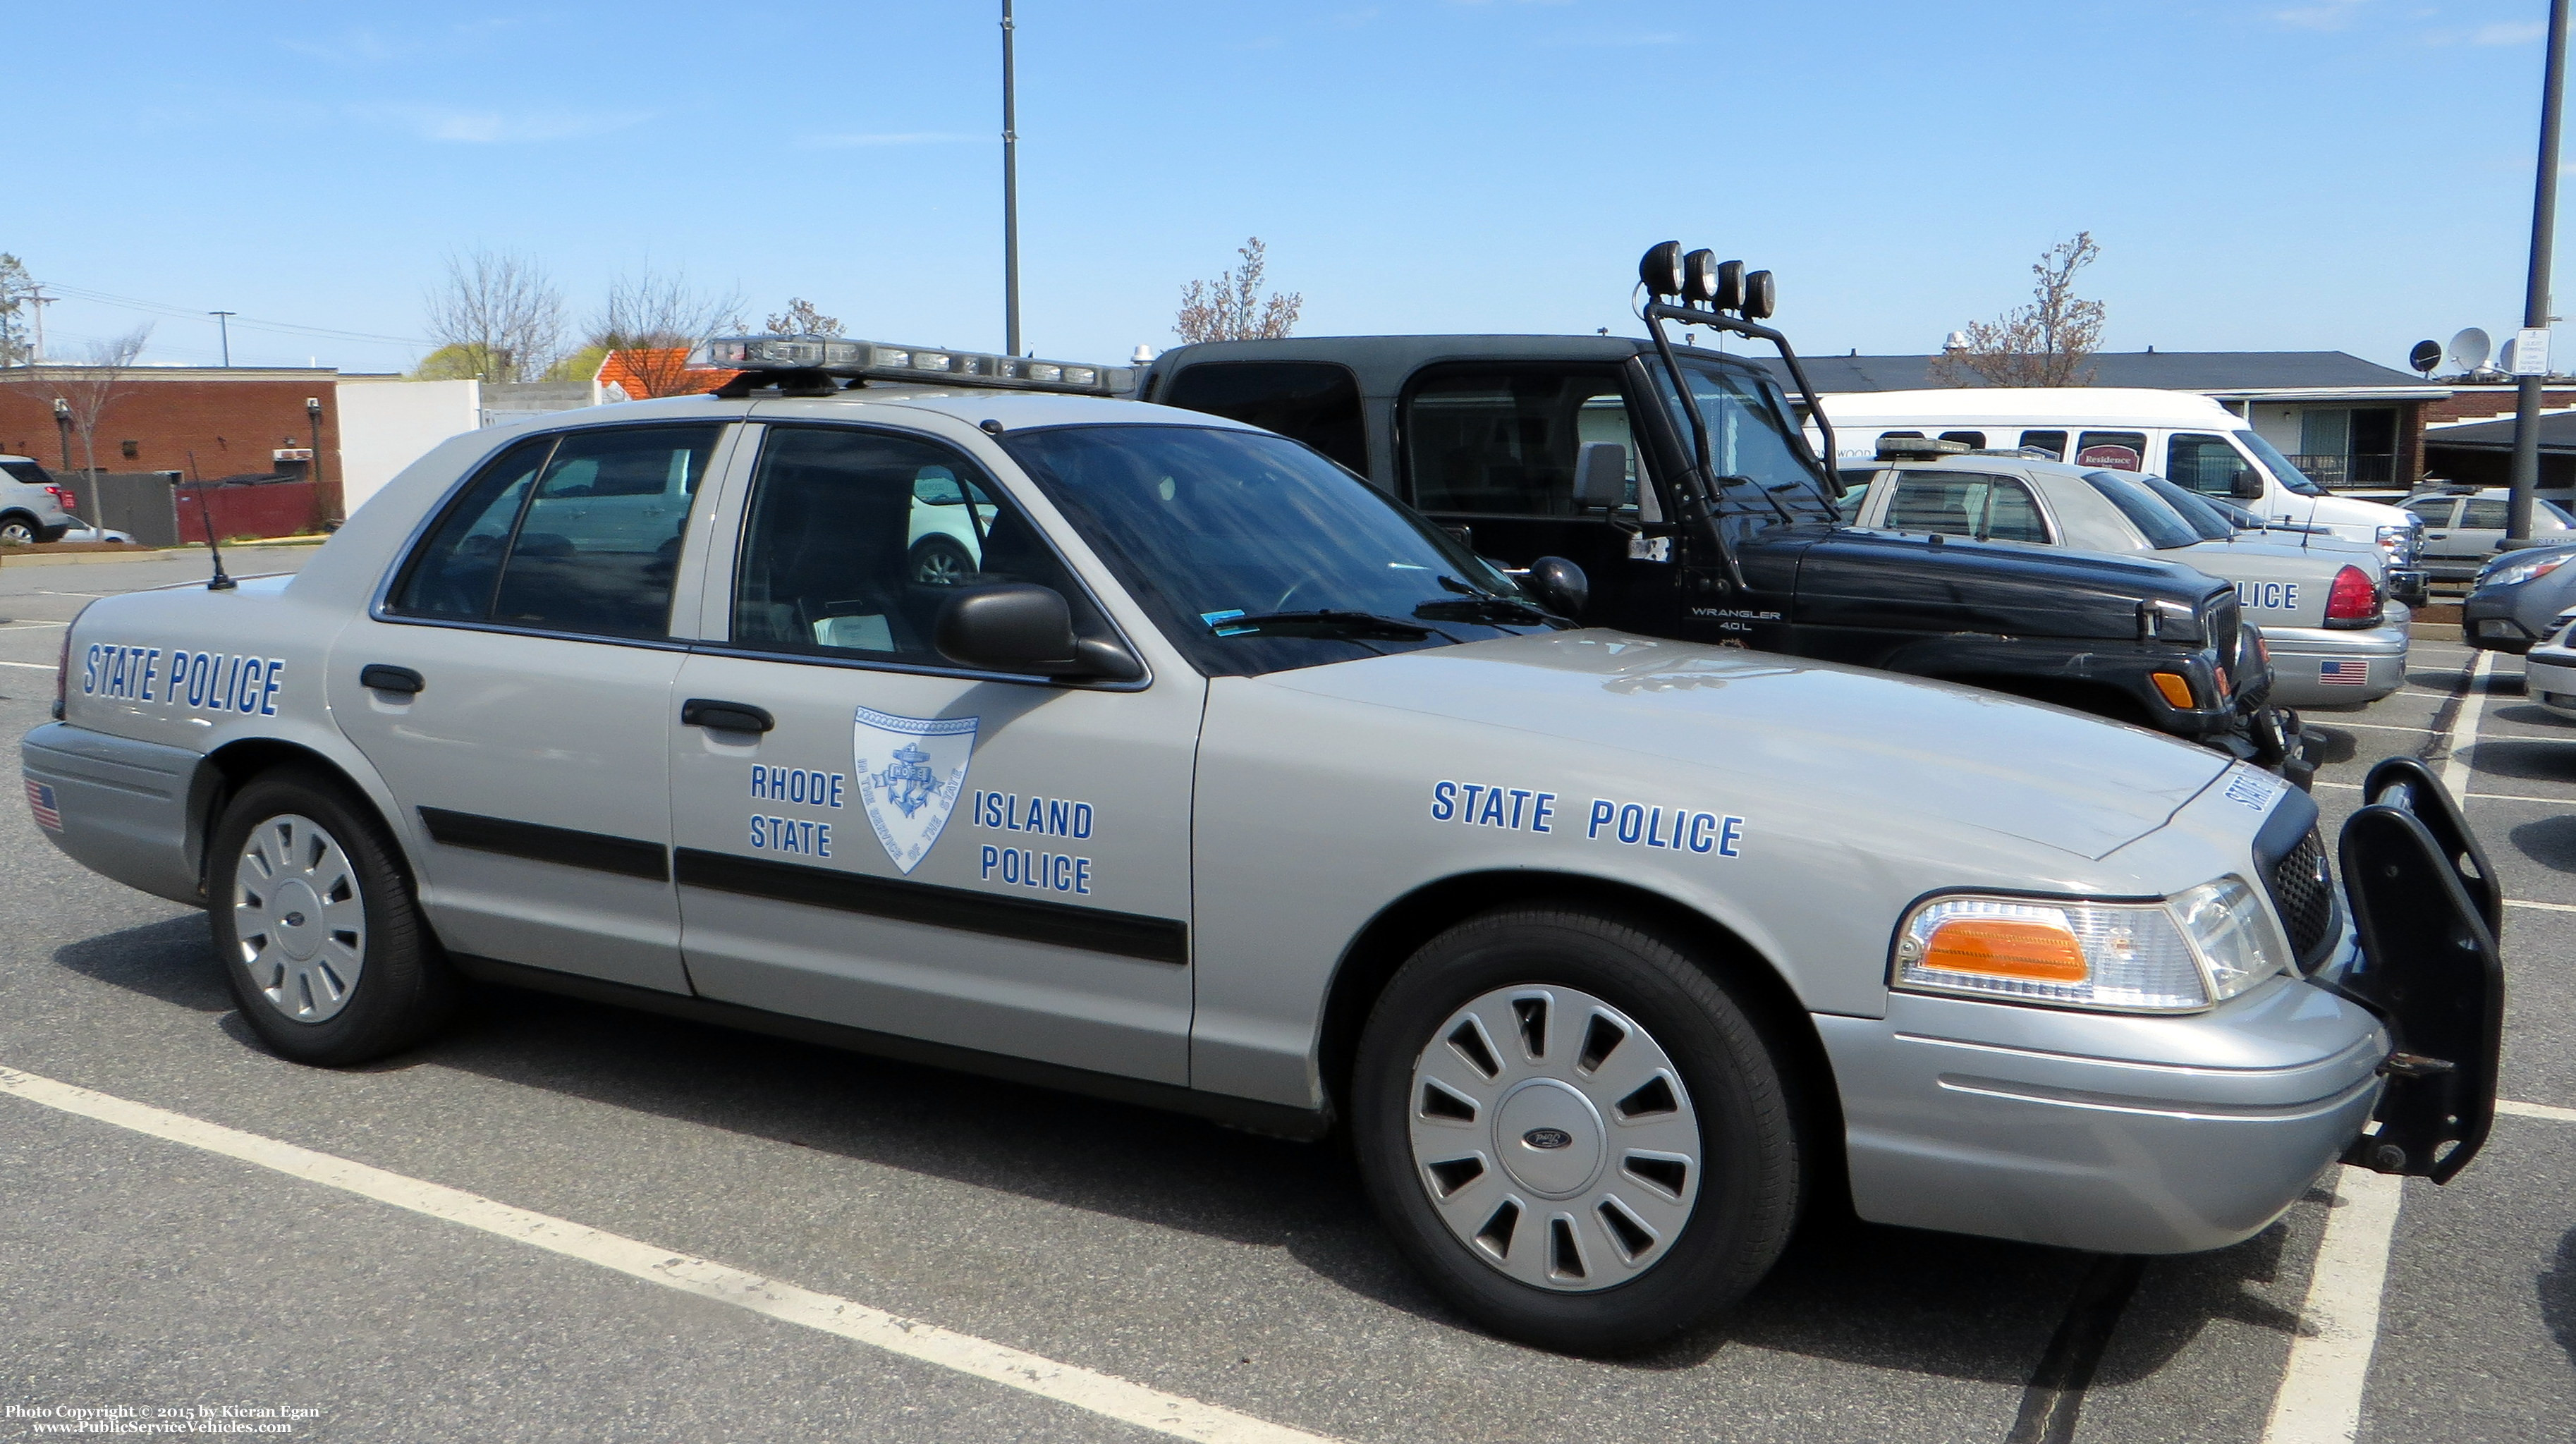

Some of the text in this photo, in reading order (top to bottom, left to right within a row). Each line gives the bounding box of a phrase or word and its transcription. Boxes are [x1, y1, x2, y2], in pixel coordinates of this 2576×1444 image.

[2085, 455, 2131, 464] Residence
[1692, 607, 1781, 620] WRANGLER
[2236, 581, 2299, 610] LICE
[84, 643, 286, 717] STATE POLICE
[751, 764, 845, 809] RHODE
[895, 766, 924, 778] HOPE
[750, 814, 832, 858] STATE
[861, 777, 876, 805] THE
[870, 807, 903, 860] SERVICE
[908, 843, 922, 861] OF
[922, 814, 942, 841] THE
[939, 768, 963, 811] STATE
[973, 790, 1094, 840] ISLAND
[1431, 780, 1746, 859] STATE POLICE
[981, 844, 1092, 895] POLICE
[1535, 1133, 1561, 1145] Ford
